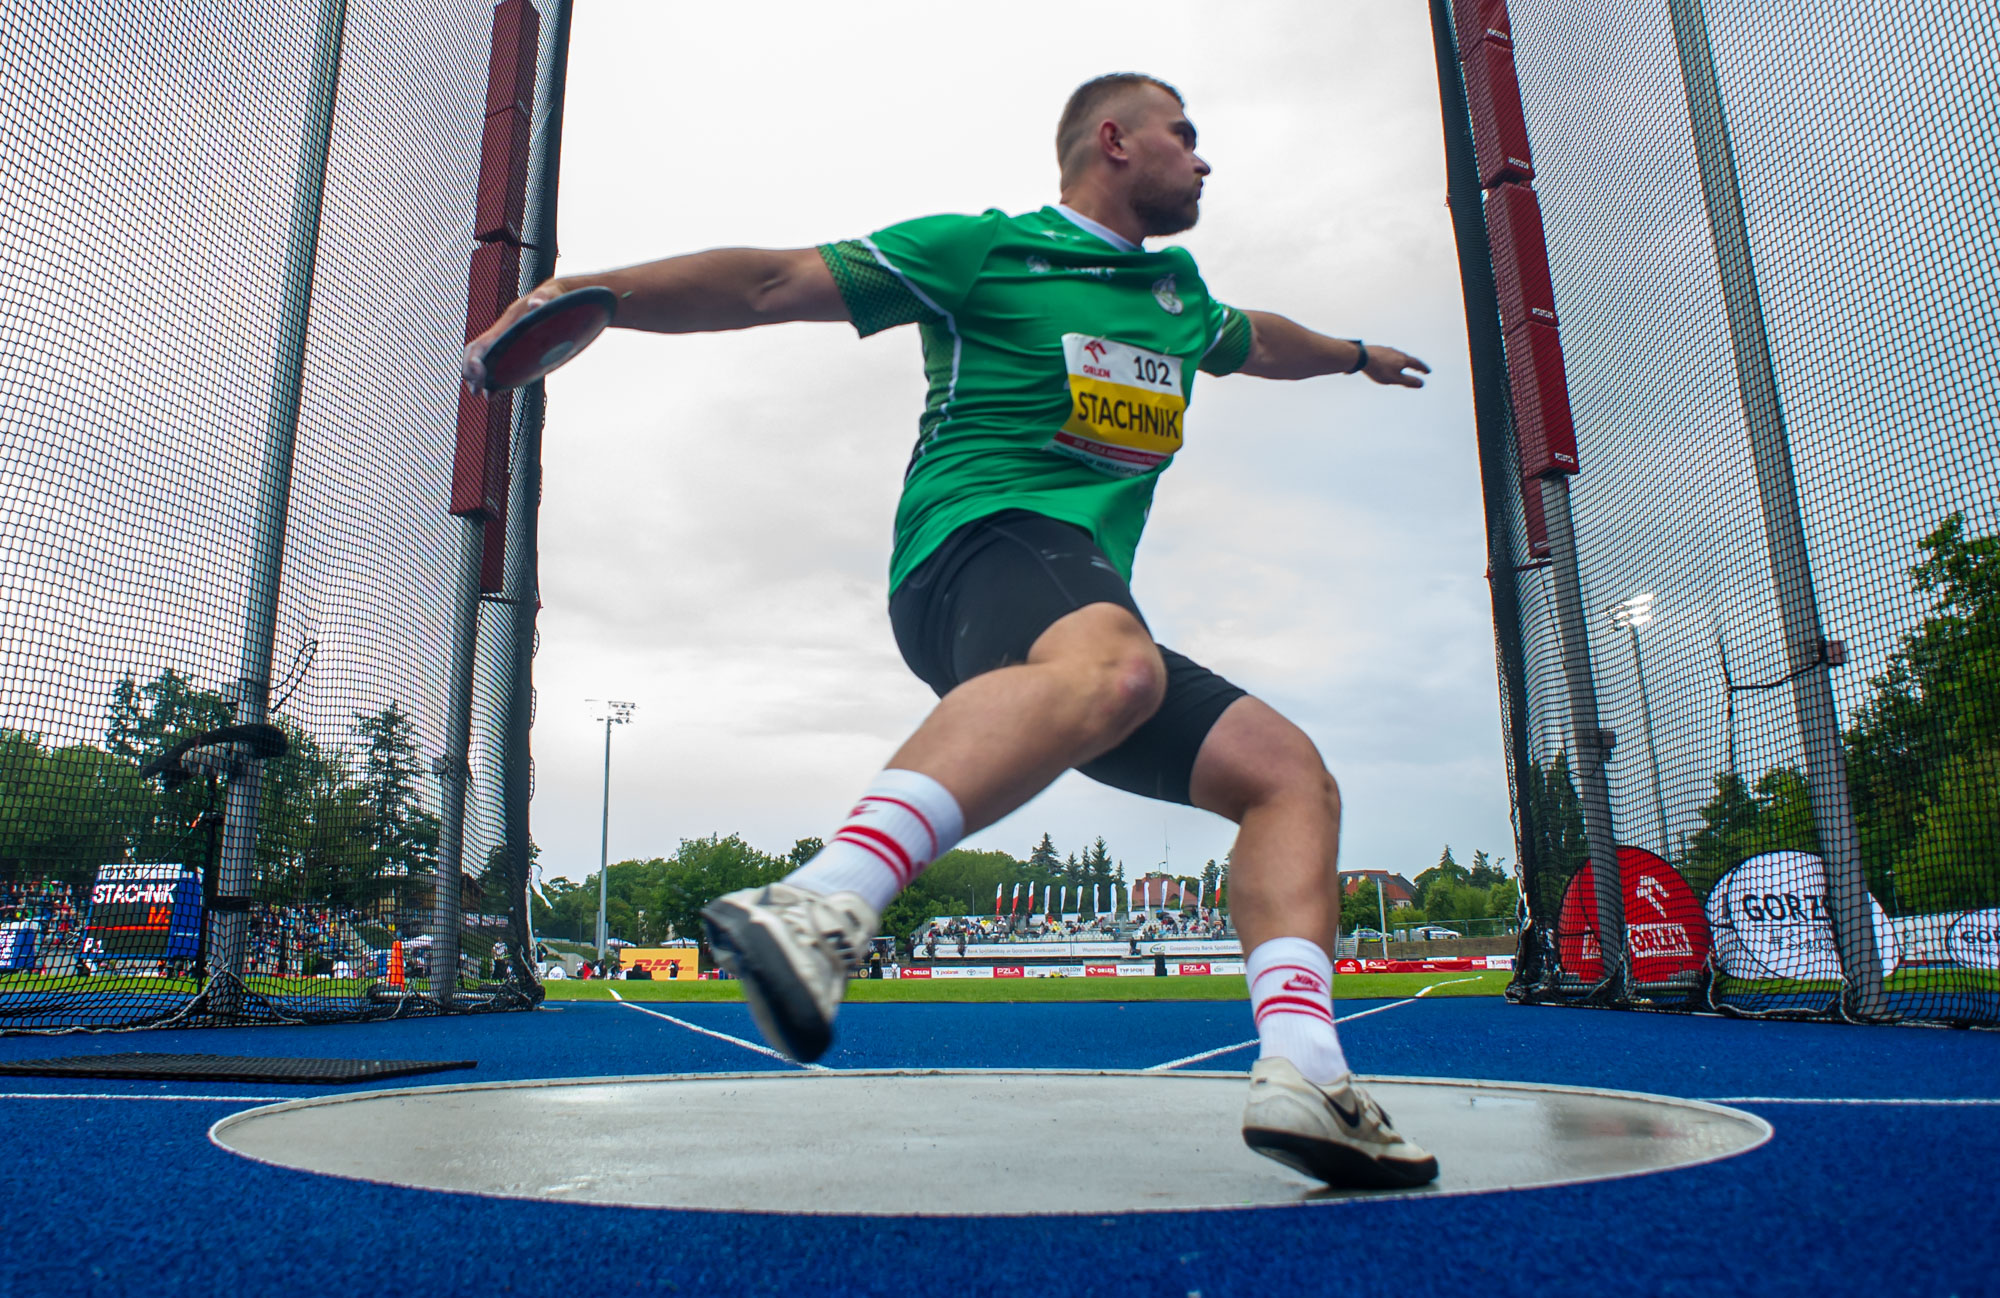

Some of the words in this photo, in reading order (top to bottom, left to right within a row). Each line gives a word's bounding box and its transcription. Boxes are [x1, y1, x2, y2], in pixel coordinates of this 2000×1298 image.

[1083, 364, 1111, 379] ORLEN
[1134, 355, 1172, 387] 102
[1078, 391, 1180, 440] STACHNIK
[92, 883, 177, 904] STACHNIK
[1743, 893, 1833, 922] GORZ
[997, 967, 1020, 975] PZLA
[1182, 964, 1207, 972] PZLA
